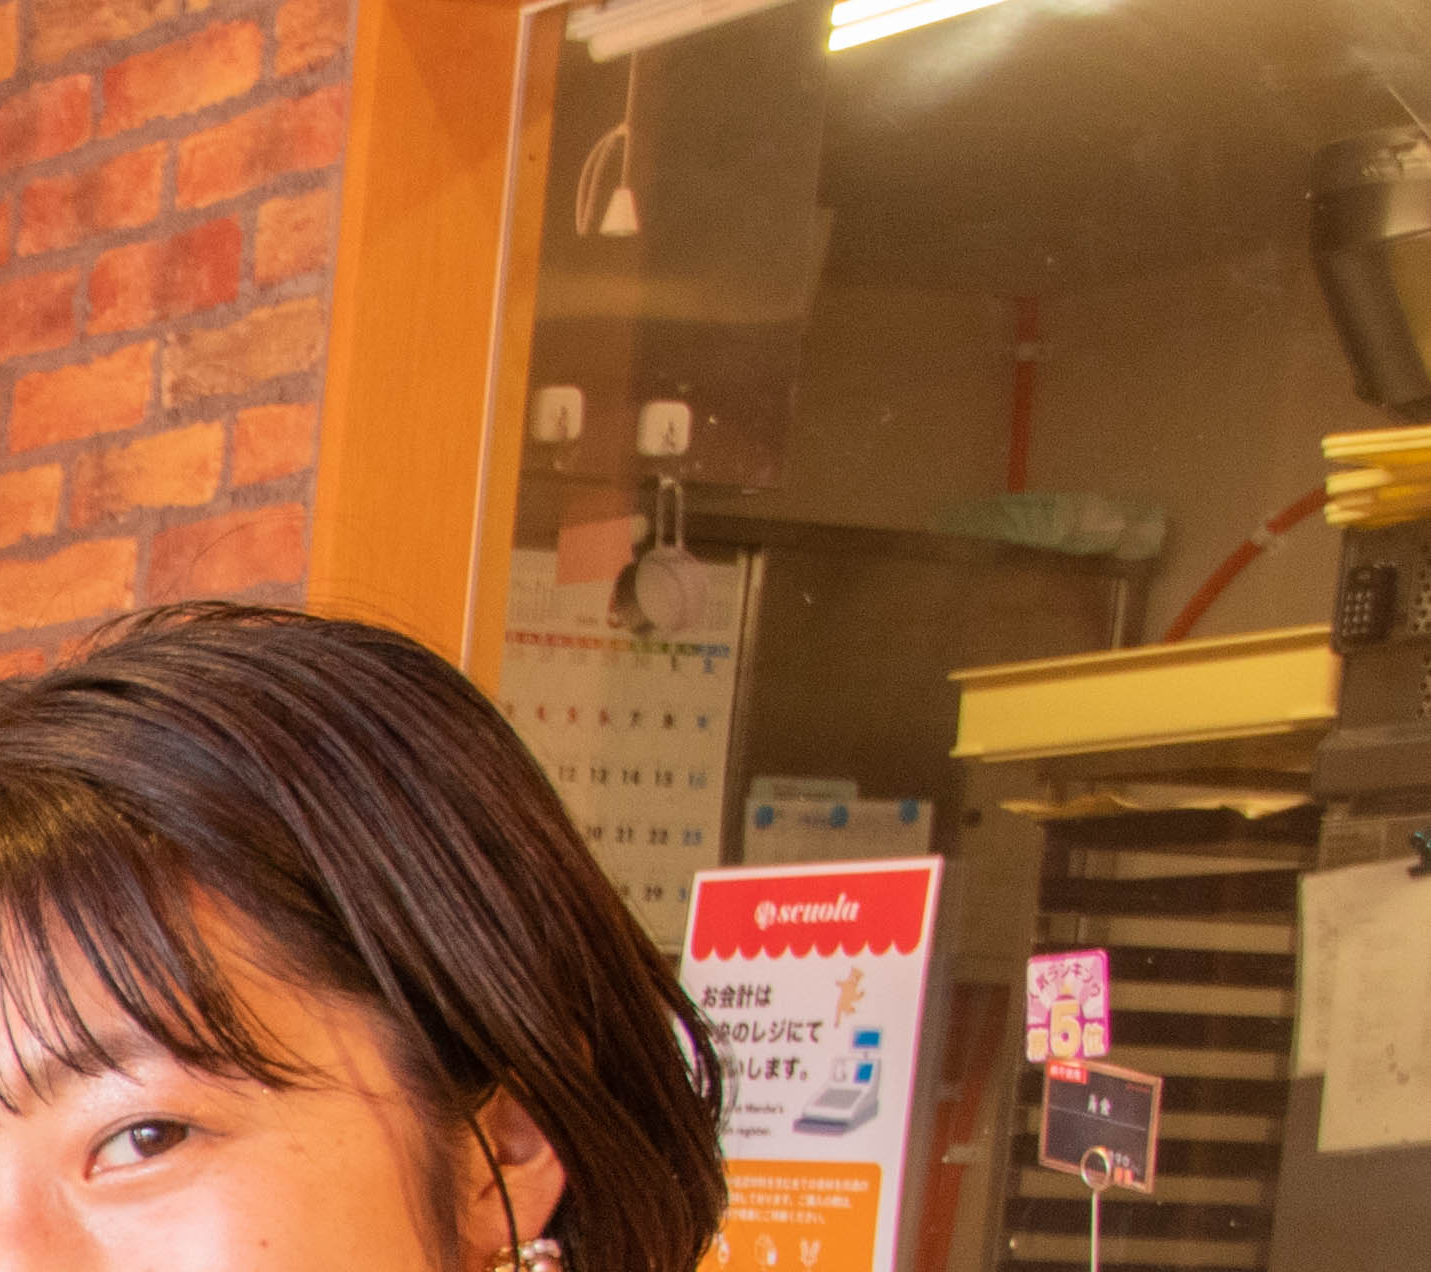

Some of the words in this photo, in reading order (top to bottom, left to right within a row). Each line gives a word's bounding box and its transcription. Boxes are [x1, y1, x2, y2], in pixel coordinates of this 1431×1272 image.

[702, 984, 771, 1009] お会計は
[711, 1020, 824, 1044] 央のレジにて
[727, 1056, 809, 1081] いします。
